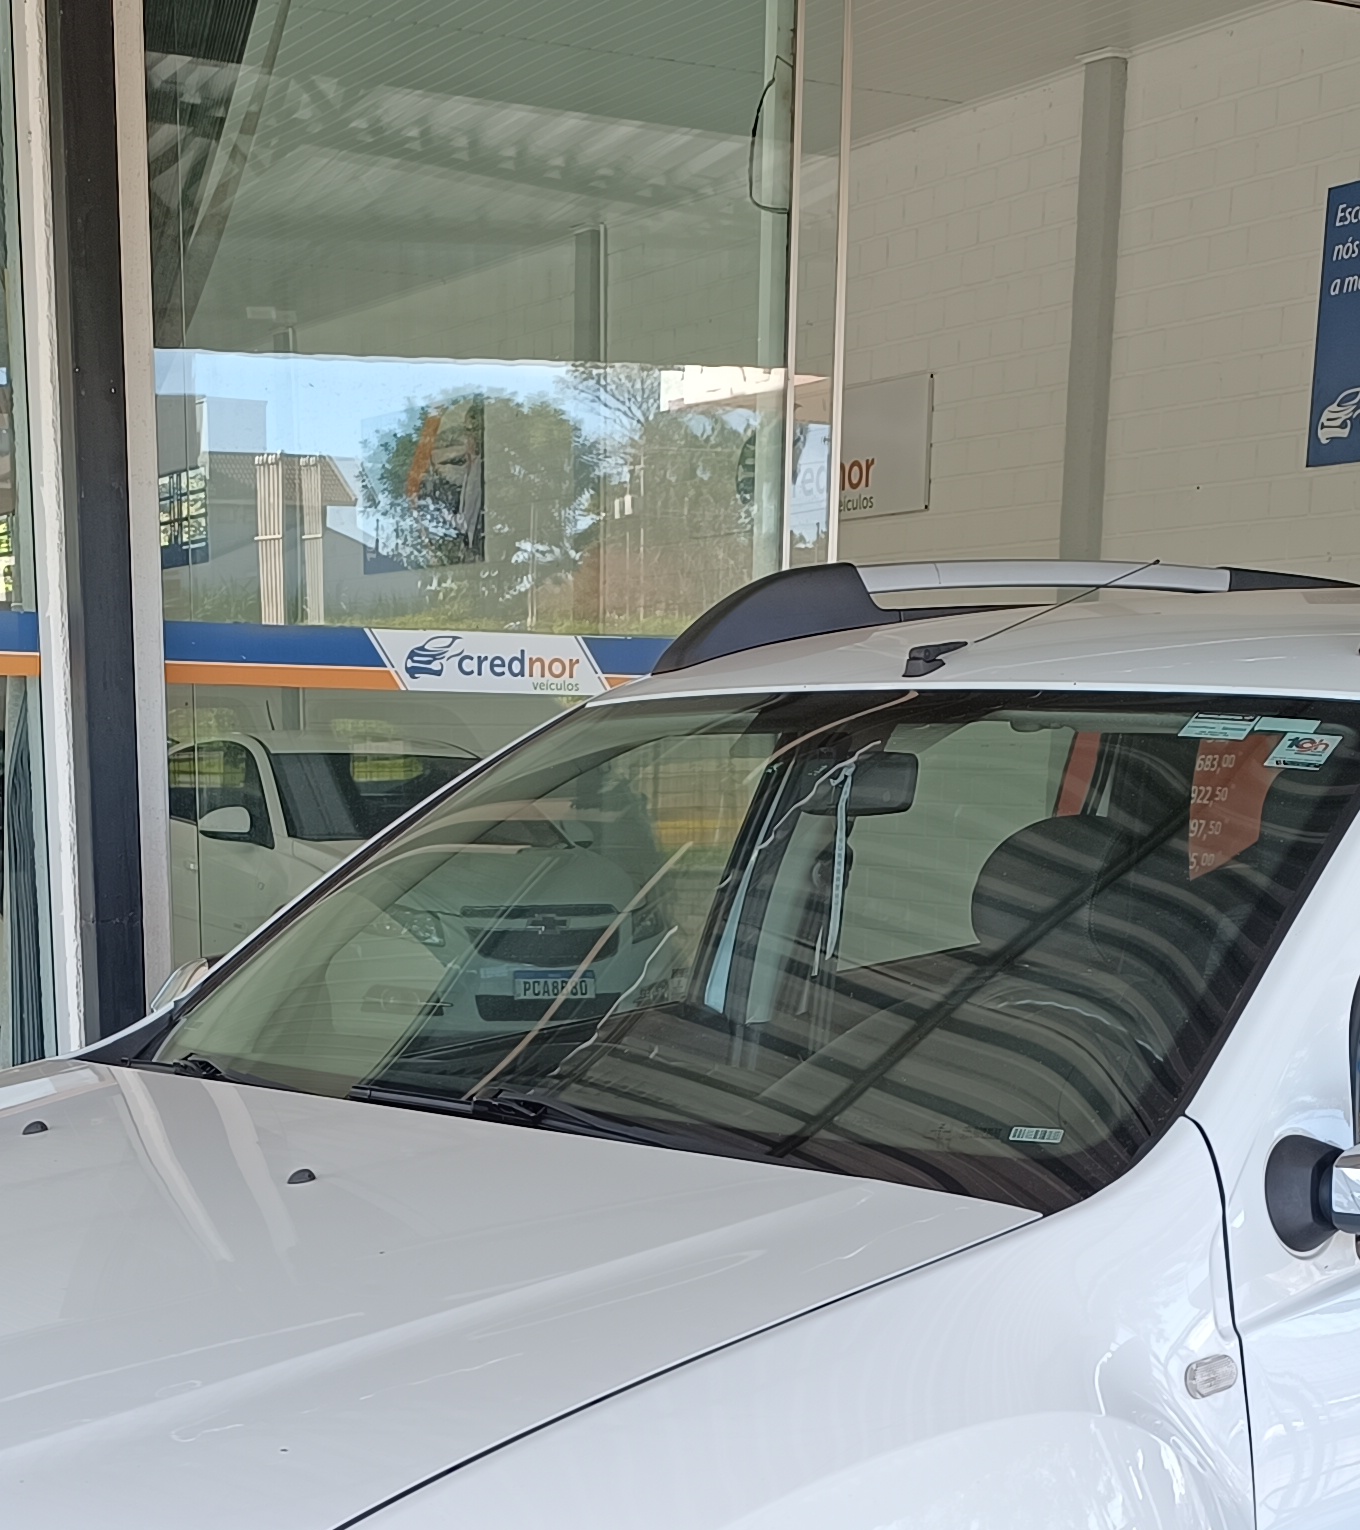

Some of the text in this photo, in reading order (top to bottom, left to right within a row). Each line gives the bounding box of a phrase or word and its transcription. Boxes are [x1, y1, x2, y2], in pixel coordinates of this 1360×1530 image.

[1332, 237, 1359, 262] nós
[1330, 277, 1341, 296] a
[457, 649, 580, 679] crednor
[532, 680, 580, 692] veículos
